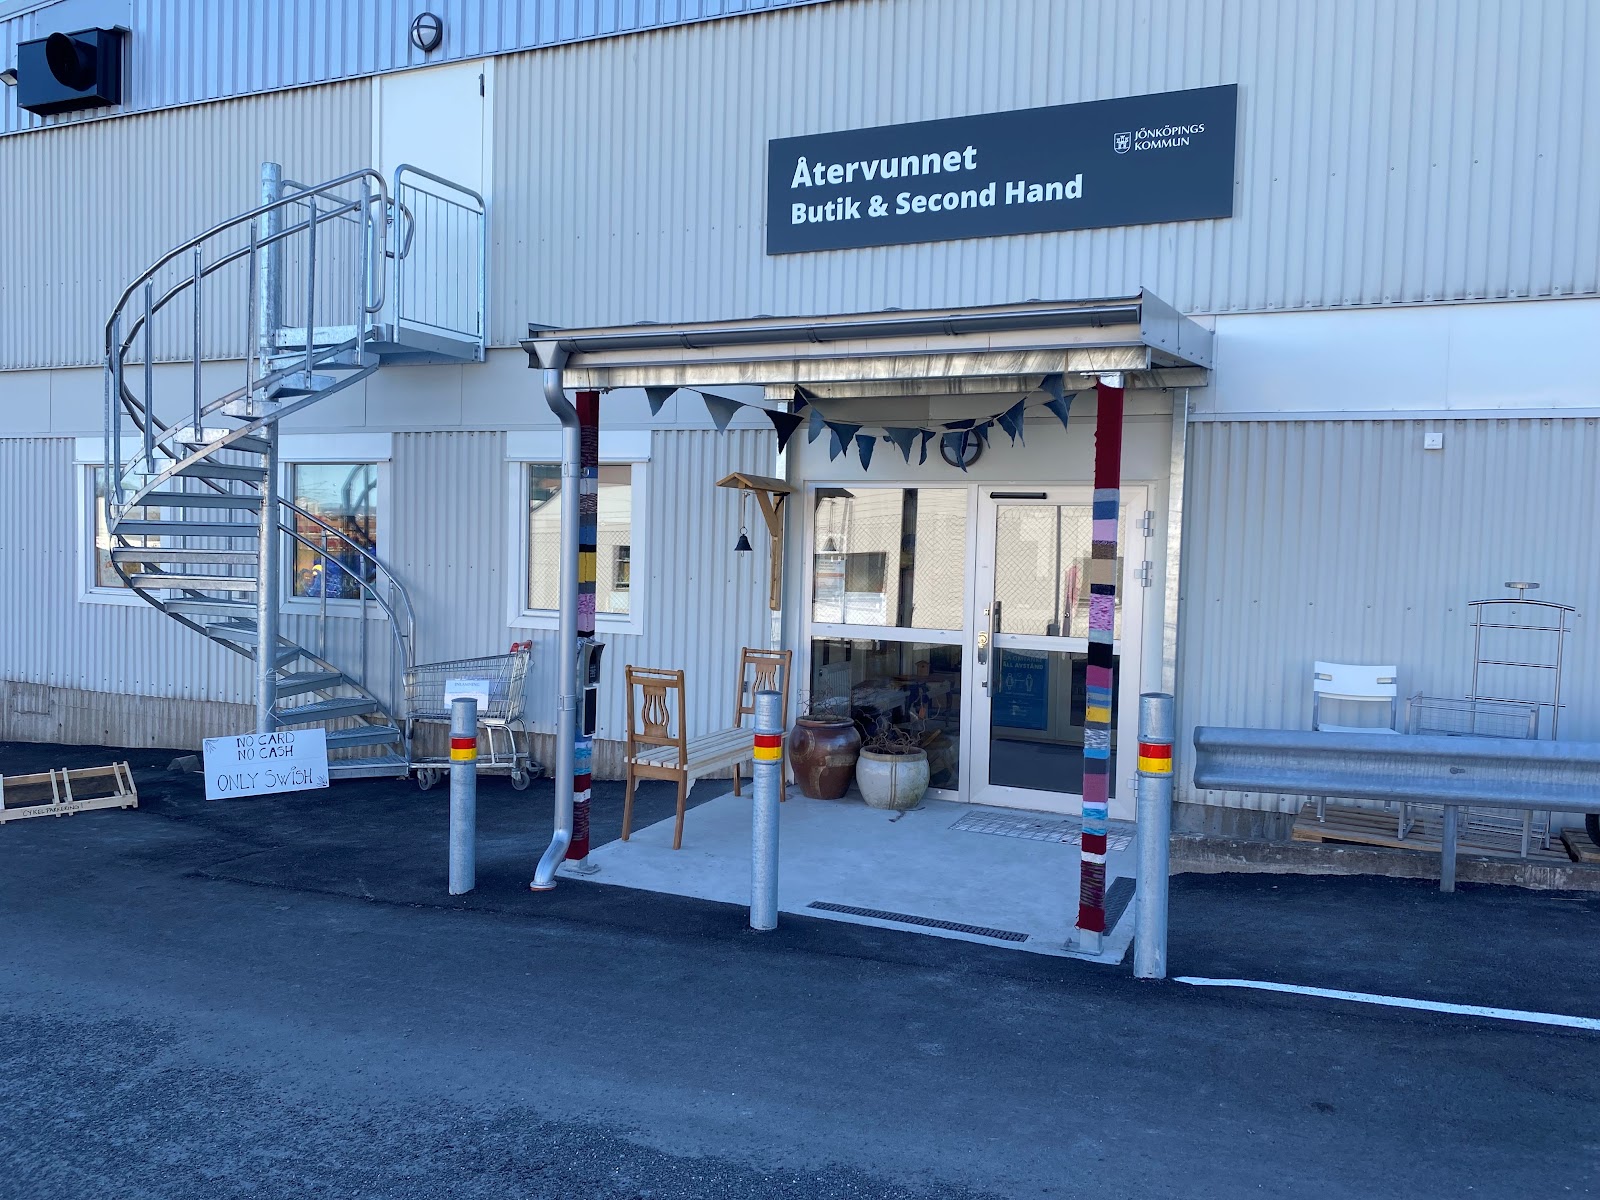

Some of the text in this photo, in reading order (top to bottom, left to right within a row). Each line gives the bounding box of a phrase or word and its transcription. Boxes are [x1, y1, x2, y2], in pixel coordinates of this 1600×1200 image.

[1134, 123, 1205, 141] JÖNKÖPINGS
[1134, 136, 1190, 151] KOMMUN
[790, 145, 978, 189] Återvunnet
[791, 173, 1083, 225] Butik & Second Hand
[237, 732, 295, 748] NO CARD
[238, 745, 294, 761] NO CASH
[217, 773, 259, 791] ONLY
